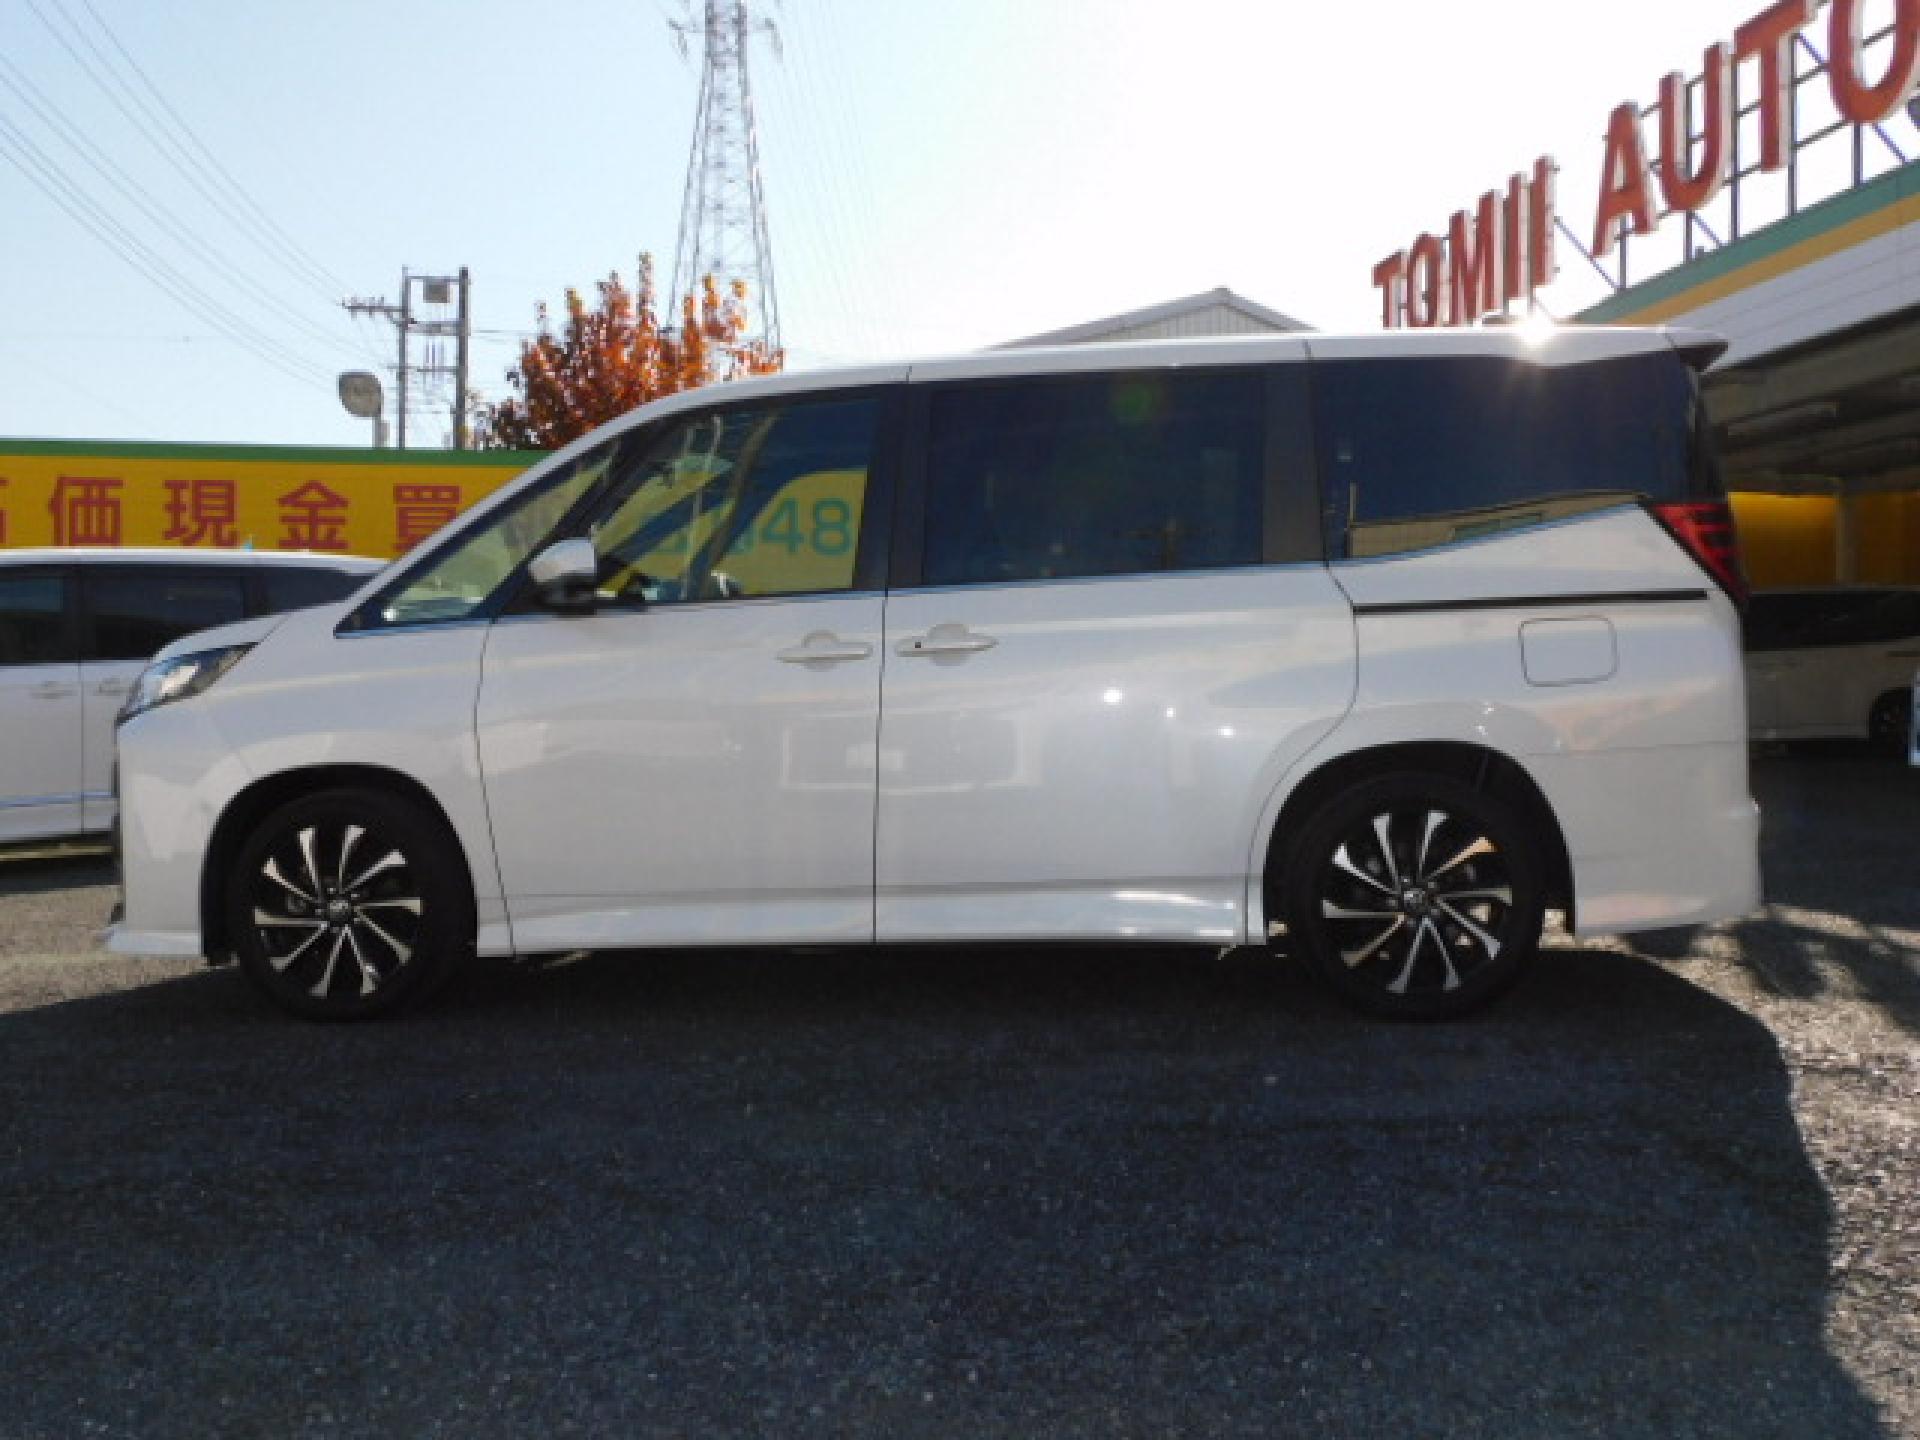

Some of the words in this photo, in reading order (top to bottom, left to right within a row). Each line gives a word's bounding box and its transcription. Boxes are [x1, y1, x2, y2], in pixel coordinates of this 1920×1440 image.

[1593, 0, 1920, 258] AUTO
[0, 475, 462, 553] 価現金買
